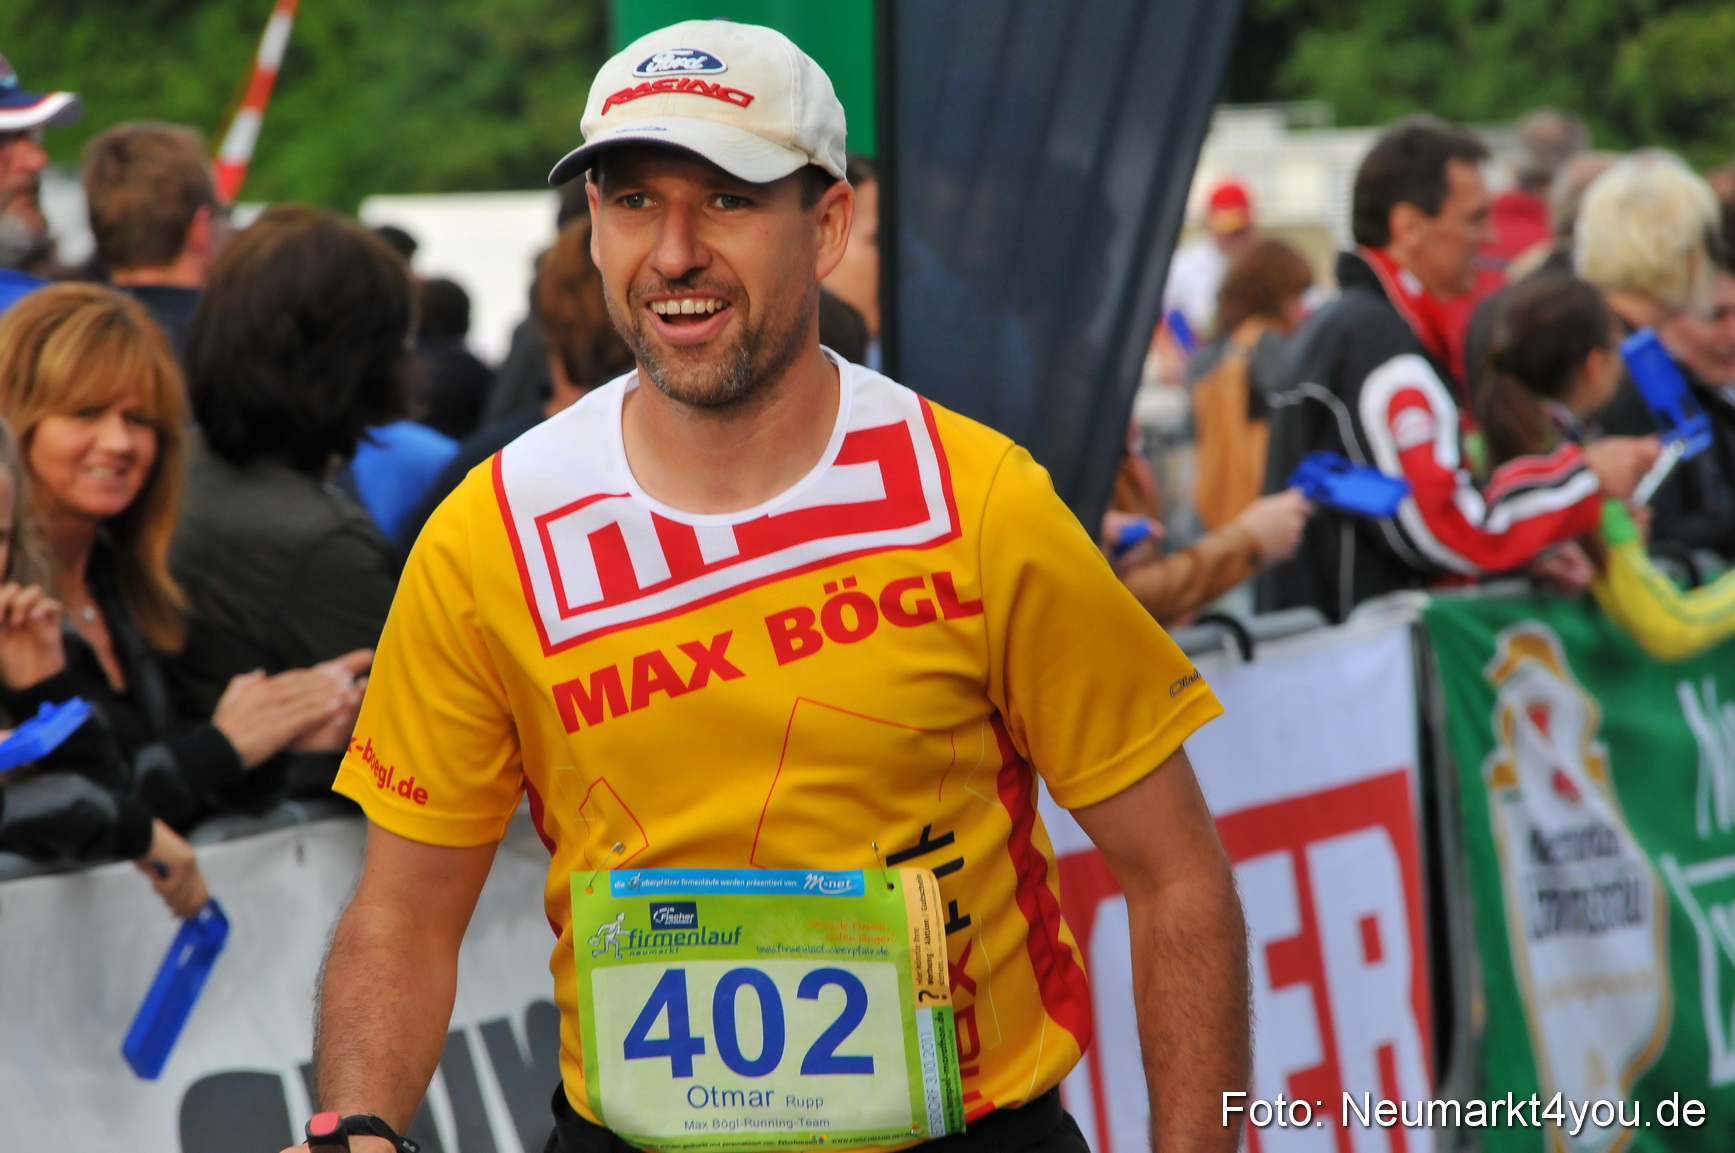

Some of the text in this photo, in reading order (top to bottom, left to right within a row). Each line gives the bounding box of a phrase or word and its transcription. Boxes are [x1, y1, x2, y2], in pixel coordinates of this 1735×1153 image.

[646, 49, 708, 73] Ford
[601, 77, 754, 116] RACING
[551, 570, 985, 735] MAX BÖGL
[720, 878, 745, 887] werden
[628, 925, 743, 950] firmenlauf
[630, 948, 679, 957] neumarkt
[623, 967, 875, 1078] 402
[687, 1085, 824, 1109] Otmar Rupp
[684, 1116, 830, 1131] Max Bögl-Running-Team
